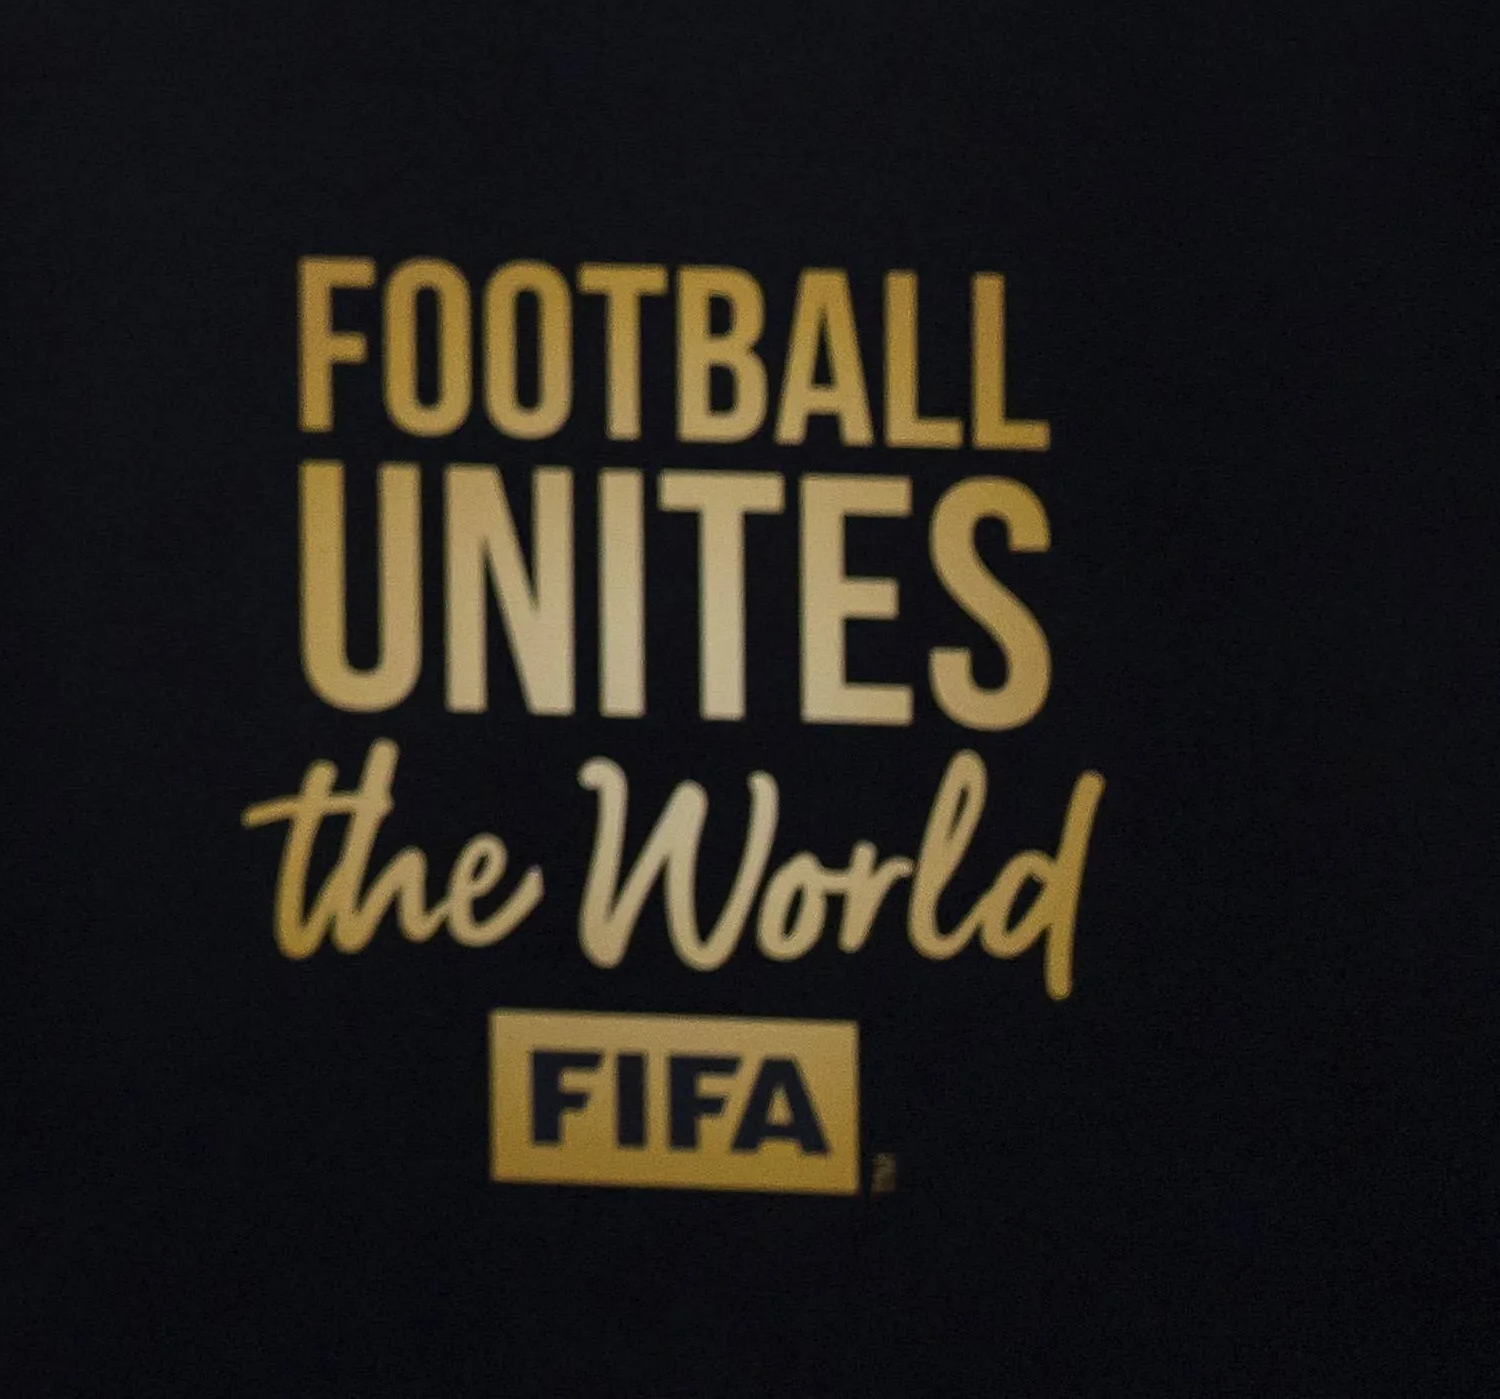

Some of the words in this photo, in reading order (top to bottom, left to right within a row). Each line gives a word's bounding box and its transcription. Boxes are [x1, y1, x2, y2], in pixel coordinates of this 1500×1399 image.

[298, 256, 1051, 451] FOOTBALL
[300, 461, 1052, 731] UNITES
[244, 739, 544, 959] the
[579, 749, 1105, 1001] World
[527, 1047, 833, 1159] FIFA
